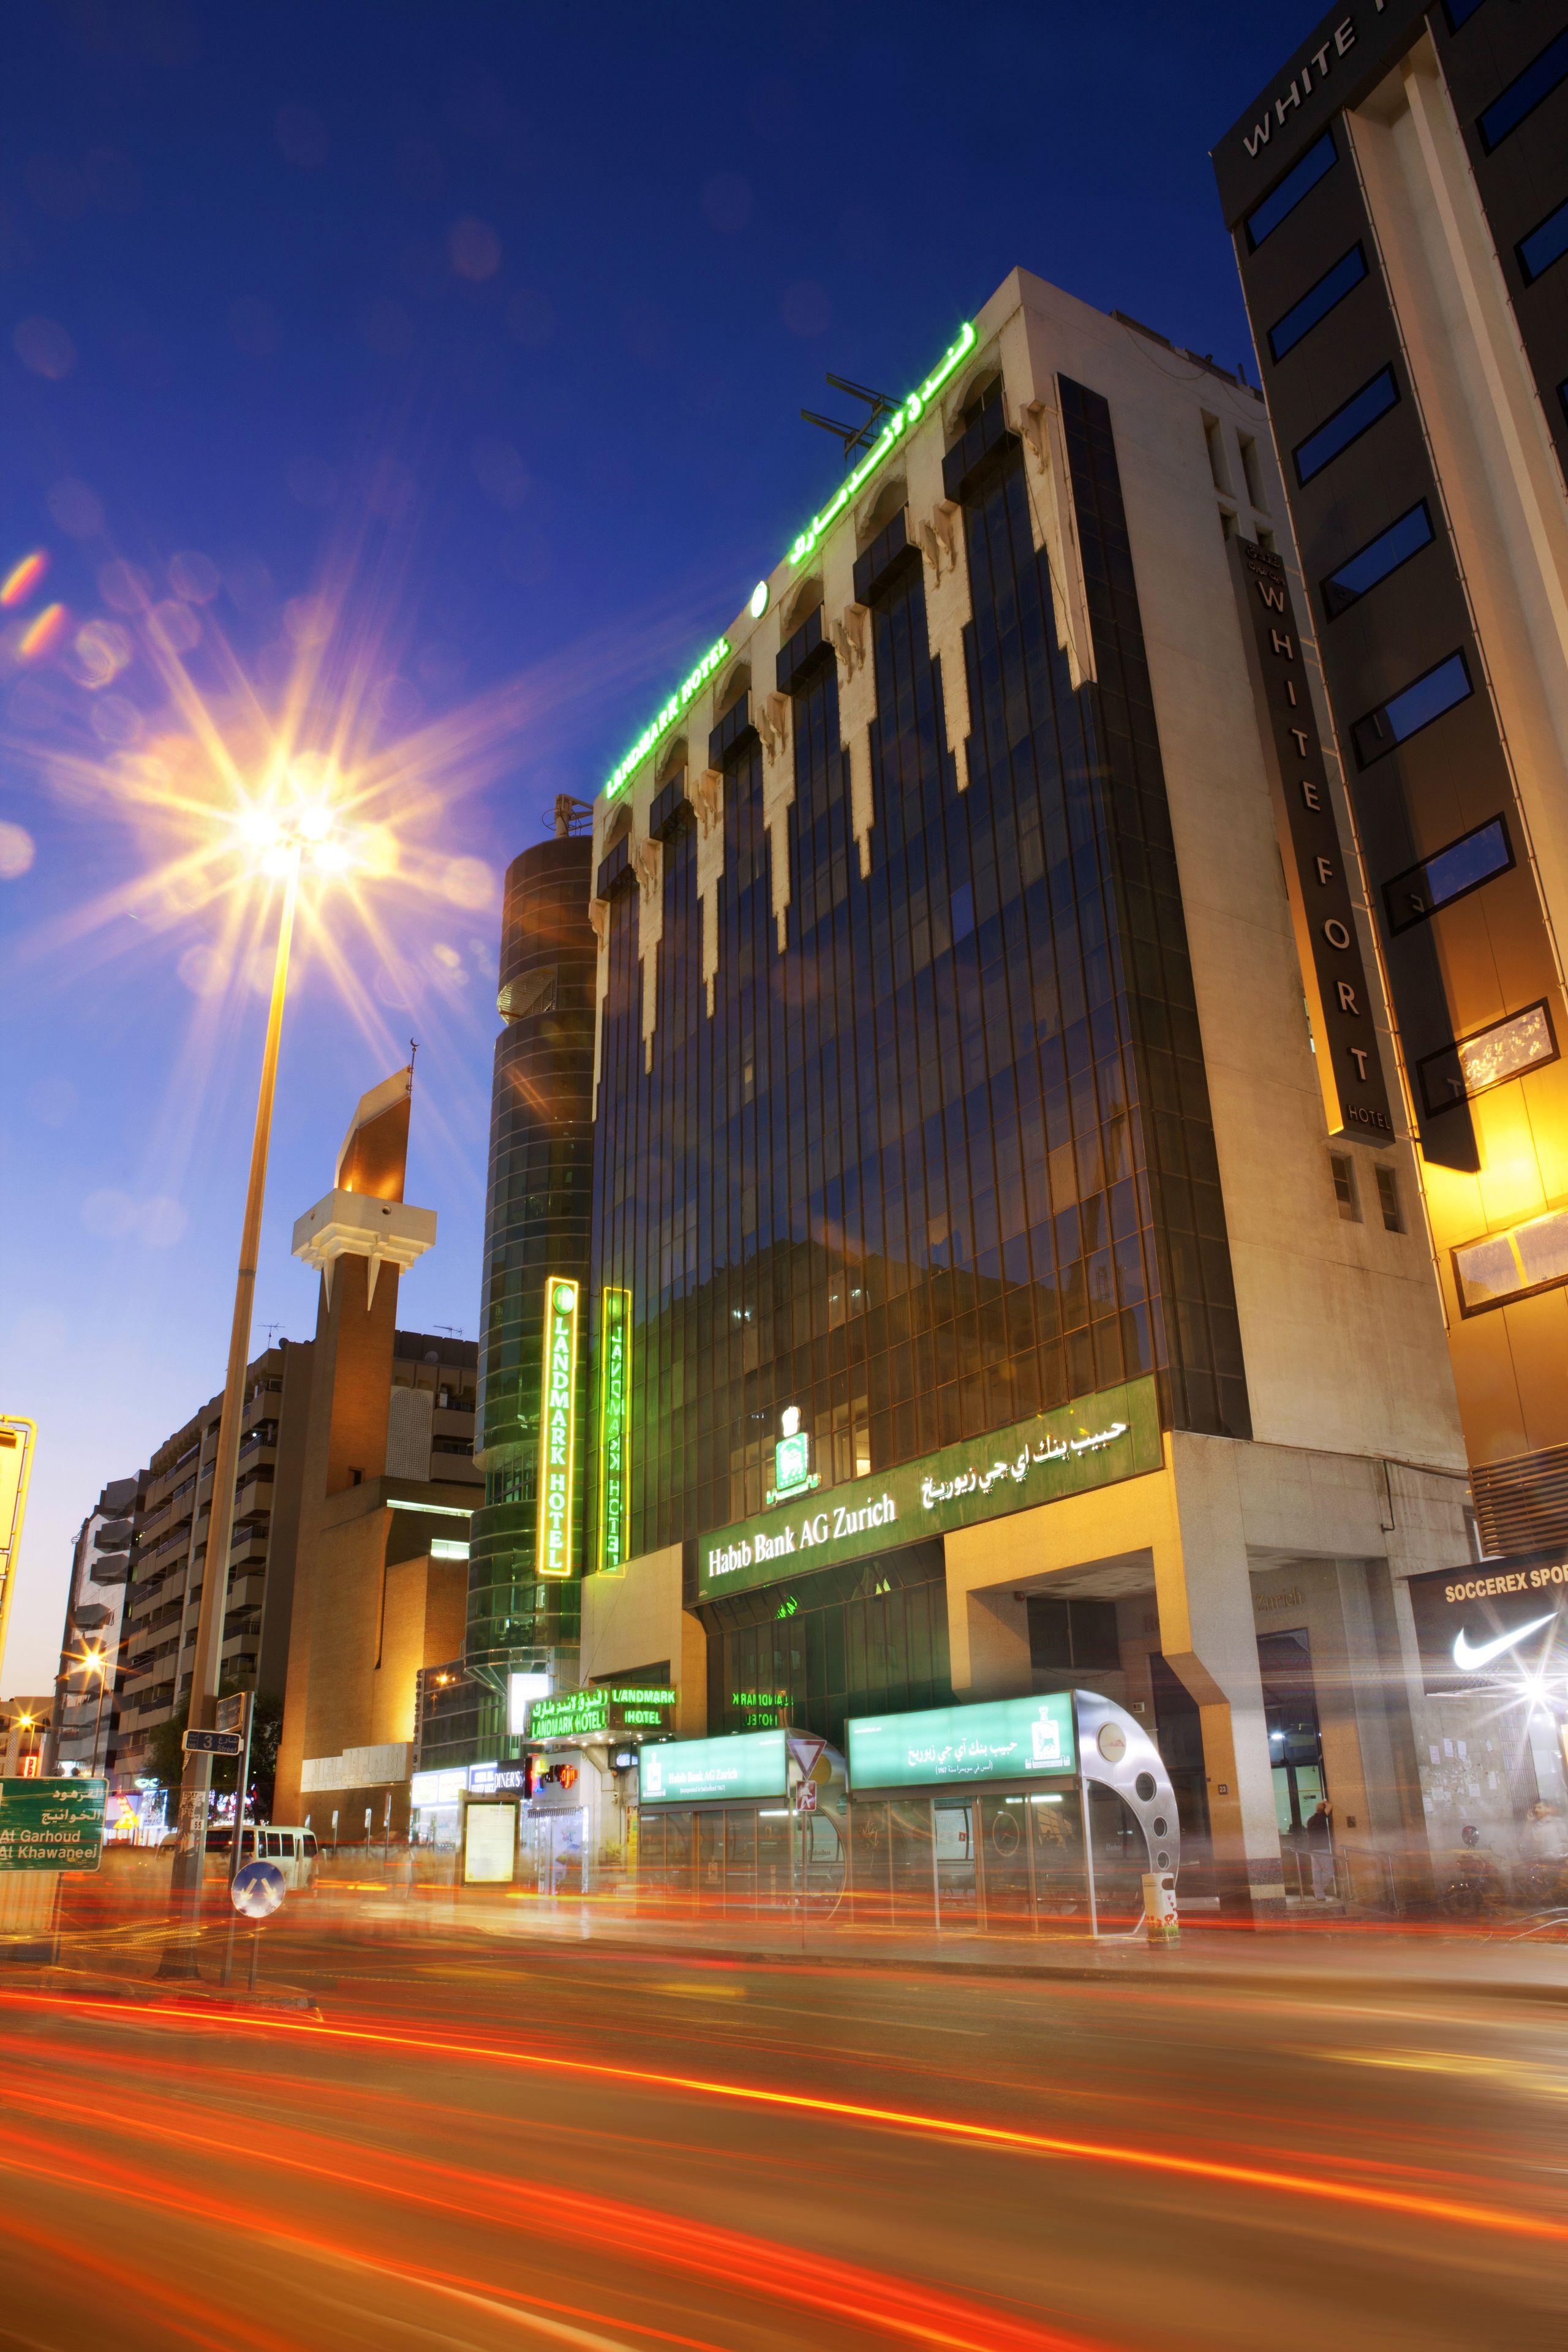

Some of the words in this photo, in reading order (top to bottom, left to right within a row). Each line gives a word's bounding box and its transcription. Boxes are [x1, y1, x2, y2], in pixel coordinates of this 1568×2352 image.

[1243, 17, 1357, 158] WHITE
[907, 322, 976, 421] فندق
[607, 695, 679, 799] LANDMARK
[681, 638, 729, 704] HOTEL
[1256, 580, 1321, 812] WHITE
[1316, 856, 1368, 1082] FORT
[1348, 1104, 1391, 1129] HOTEL
[550, 1317, 570, 1464] LANDMARK
[1033, 1436, 1069, 1463] بنك
[1070, 1422, 1128, 1456] حبيب
[979, 1461, 1008, 1494] جي
[548, 1474, 566, 1569] HOTEL
[709, 1539, 752, 1577] Habib
[754, 1526, 796, 1564] Bank
[799, 1513, 829, 1549] AG
[833, 1493, 897, 1539] Zurich
[1254, 1586, 1303, 1611] Zurich
[1445, 1572, 1529, 1603] SOCCEREX
[612, 1689, 676, 1704] LANDMARK
[532, 1716, 574, 1738] LANDMARK
[575, 1711, 603, 1733] HOTEL
[625, 1711, 662, 1724] HOTEL
[203, 1735, 213, 1749] 3
[217, 1736, 238, 1744] شارع
[217, 1744, 237, 1753] Street
[968, 1739, 988, 1757] بنك
[989, 1741, 1018, 1757] حبيب
[494, 1770, 522, 1788] DINER'S
[668, 1772, 687, 1784] Habib
[687, 1770, 704, 1782] Bank
[704, 1769, 715, 1781] AG
[716, 1767, 738, 1781] Zurich
[40, 1809, 100, 1825] الخوانيج
[20, 1830, 81, 1842] Garhoud
[18, 1844, 97, 1859] Khawaneej
